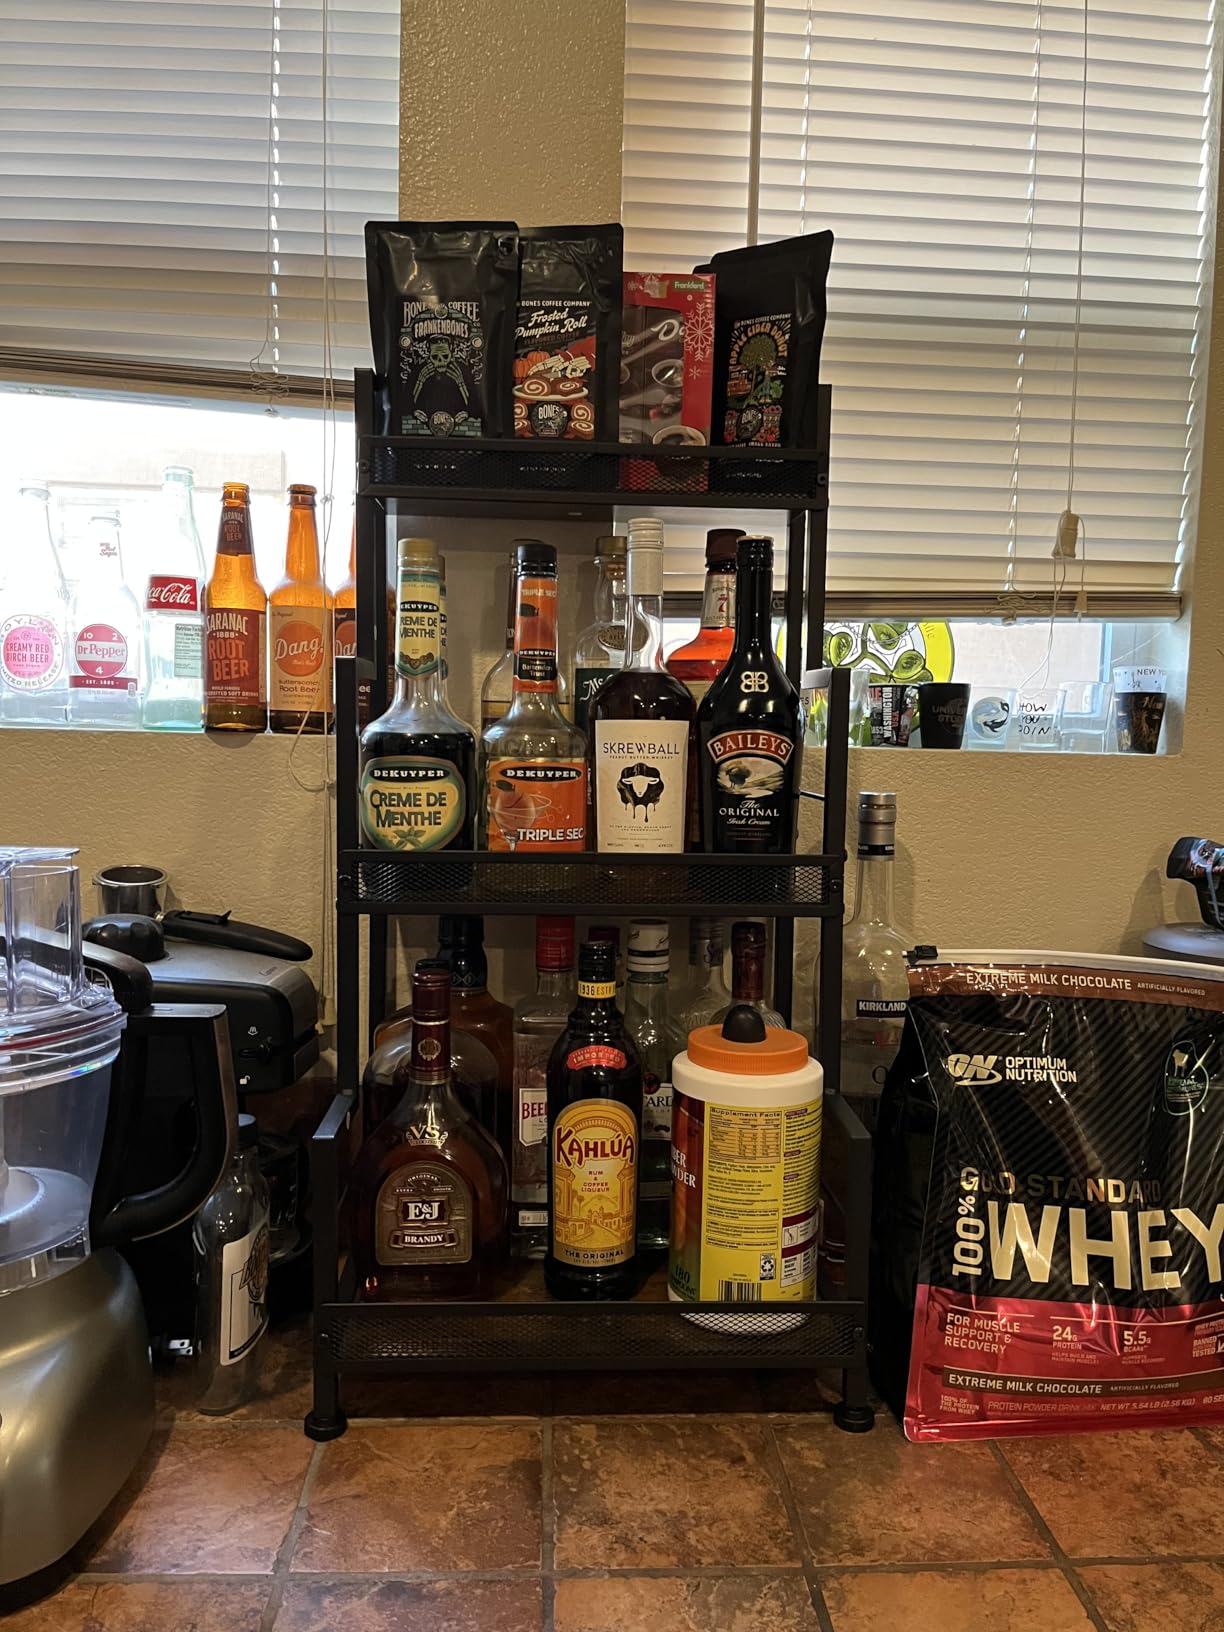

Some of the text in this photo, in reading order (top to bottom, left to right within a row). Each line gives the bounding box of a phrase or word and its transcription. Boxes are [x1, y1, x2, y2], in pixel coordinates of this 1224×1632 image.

[448, 301, 480, 321] COFFEE
[528, 307, 569, 327] Frosted
[414, 319, 469, 339] FRANKENBONES
[515, 315, 588, 339] Pumpkin Roll
[747, 322, 772, 338] CIDER
[770, 325, 789, 358] DONUT
[401, 602, 438, 611] EKUYPER
[206, 612, 249, 636] SARANAC
[400, 615, 437, 628] REME DE
[83, 632, 119, 640] 10 2
[6, 642, 50, 654] CREAMY RED
[77, 643, 126, 658] Dr Pepper
[208, 639, 246, 660] ROOT
[29, 653, 49, 663] BEER
[95, 666, 104, 675] 4
[212, 659, 250, 681] BEER
[1136, 668, 1157, 676] NEW
[279, 685, 321, 694] Root Beer
[883, 687, 893, 738] WASHINGTON
[1020, 702, 1047, 713] HOW
[602, 742, 680, 756] SKREWBALL
[713, 734, 790, 758] BAILEYS
[373, 769, 446, 778] DEKUYPER
[506, 769, 577, 778] DEKUYPER
[370, 789, 447, 809] CREME DE
[739, 800, 760, 809] The
[375, 806, 442, 828] MENTHE
[718, 807, 780, 817] ORIGINAL
[517, 827, 585, 841] TRIPLE SEC
[965, 972, 1027, 985] EXTREME
[1029, 973, 1059, 986] MILK
[1061, 974, 1133, 991] CHOCOLATE
[858, 1000, 907, 1013] KIRKLAND
[1005, 1056, 1067, 1070] OPTIMUM
[1005, 1068, 1078, 1083] NUTRITION
[710, 1108, 757, 1118] Supplement
[409, 1124, 441, 1140] VS
[959, 1166, 1162, 1204] GOD STANDARD
[406, 1201, 441, 1221] E&J
[404, 1234, 445, 1244] BRANDY
[951, 1195, 986, 1277] 100%
[986, 1200, 1224, 1292] WHEY
[565, 1249, 625, 1260] THE ORIGINAL
[946, 1312, 1021, 1334] FOR MUSCLE
[944, 1324, 1013, 1344] SUPPORT &
[943, 1336, 1007, 1354] RECOVERY
[1052, 1341, 1083, 1351] PROTEIN
[1192, 1347, 1217, 1359] TESTED
[948, 1373, 1004, 1391] EXTREME
[1006, 1380, 1034, 1393] MILK
[1036, 1382, 1103, 1395] CHOCOLATE
[988, 1400, 1023, 1412] PROTEIN
[1023, 1401, 1058, 1412] POWDER
